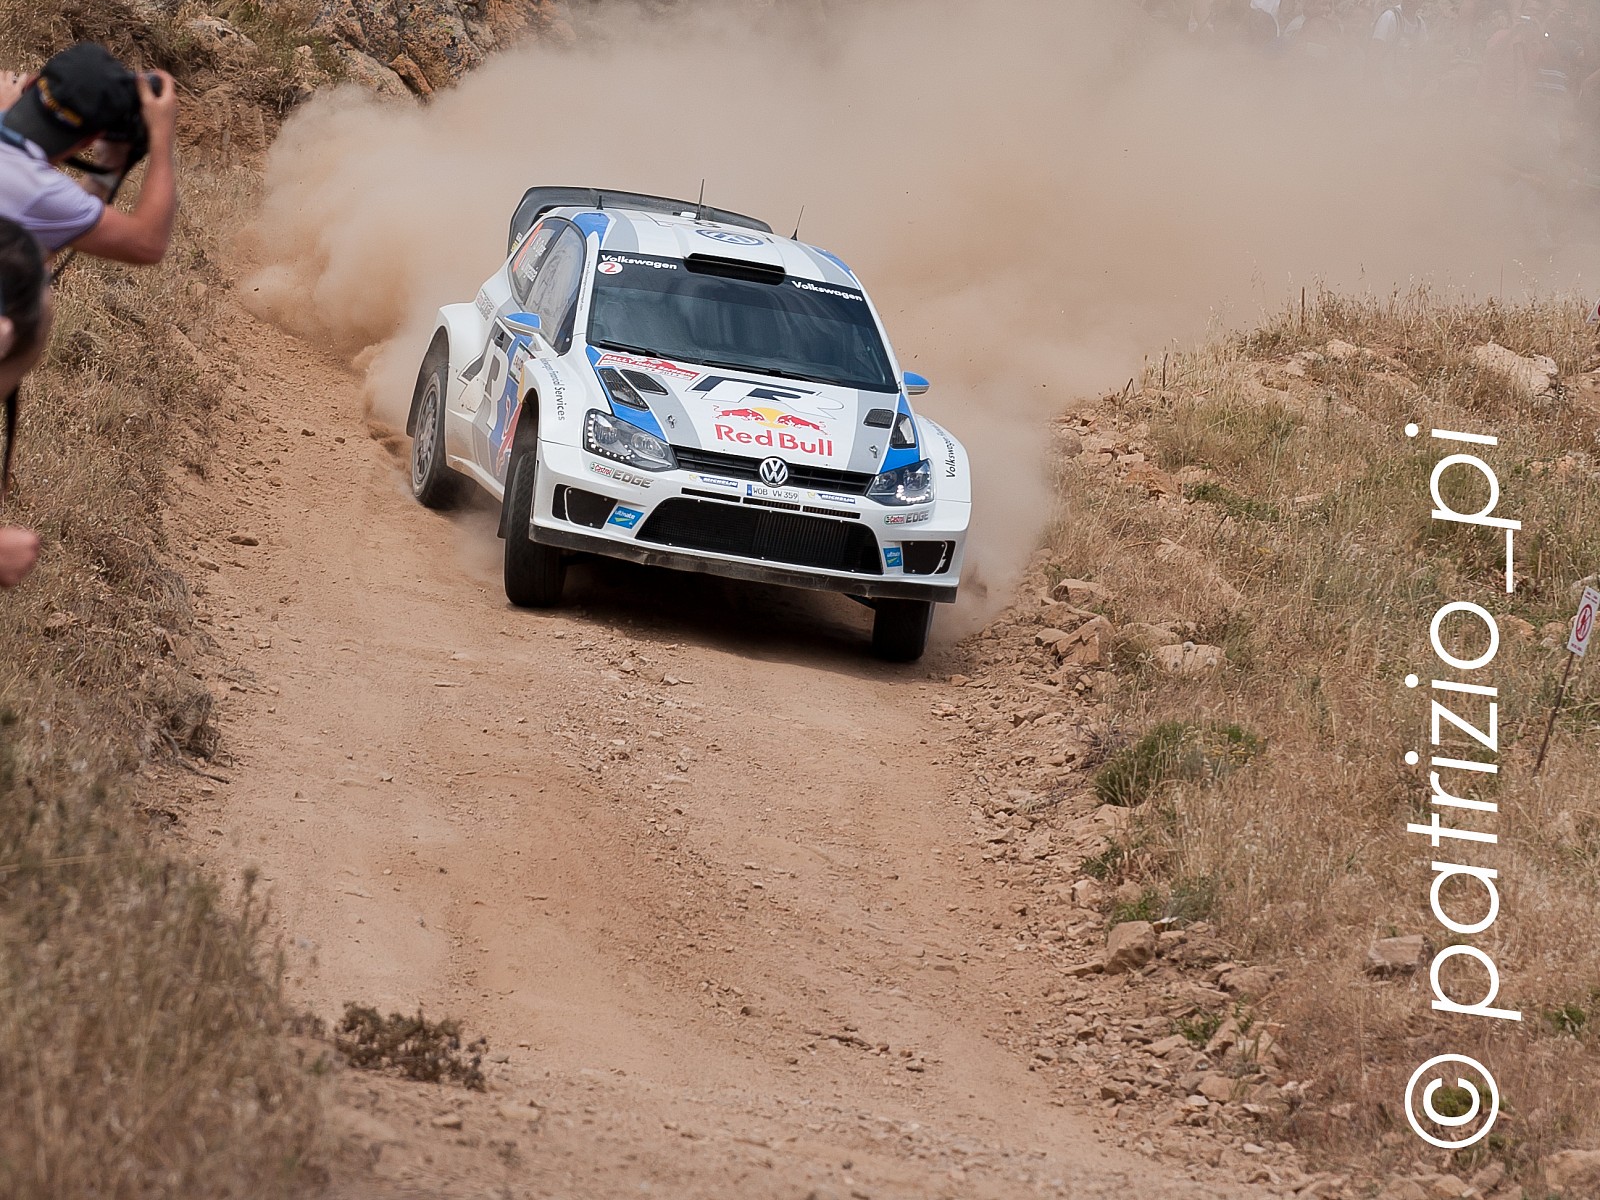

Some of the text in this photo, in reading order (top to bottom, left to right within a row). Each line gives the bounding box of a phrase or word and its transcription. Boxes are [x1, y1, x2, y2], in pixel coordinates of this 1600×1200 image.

[601, 254, 678, 270] Volkswagen
[603, 263, 616, 273] 2
[791, 280, 863, 301] Volkswagen
[554, 386, 567, 421] Services
[714, 423, 833, 456] Red Bull
[612, 469, 654, 489] EDGE
[753, 486, 768, 496] WOB
[785, 490, 798, 499] 359
[905, 510, 929, 524] EDGE
